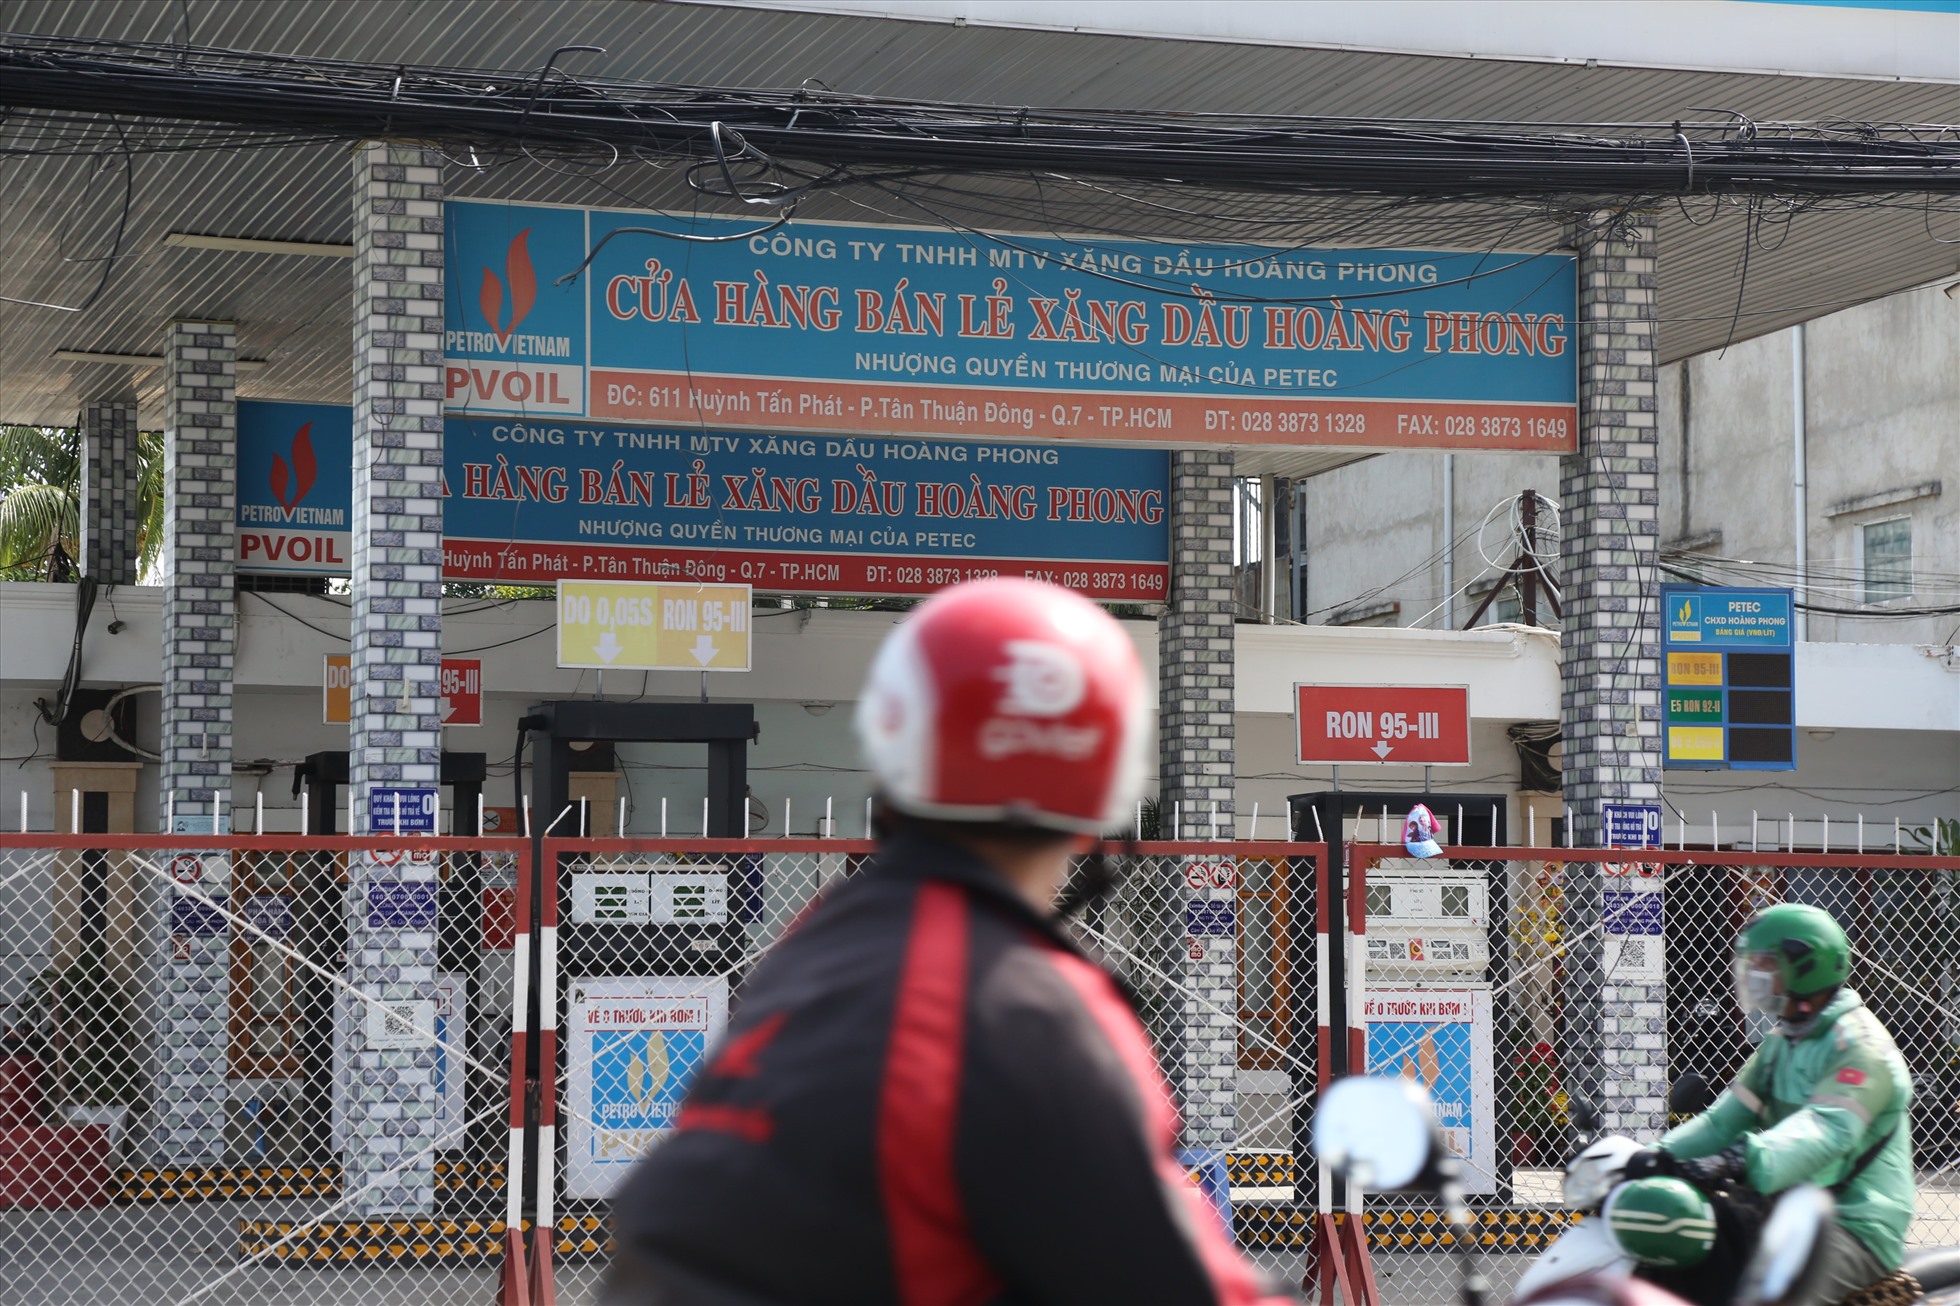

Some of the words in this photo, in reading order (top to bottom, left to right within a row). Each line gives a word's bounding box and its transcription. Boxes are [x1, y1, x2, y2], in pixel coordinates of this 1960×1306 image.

[749, 232, 837, 259] CÔNG
[848, 241, 884, 262] TY
[900, 244, 977, 266] TNHH
[990, 249, 1048, 270] MTV
[1059, 248, 1142, 275] XĂNG
[1153, 250, 1214, 277] DẦU
[1224, 253, 1326, 281] HOÀNG
[1338, 263, 1438, 284] PHONG
[606, 258, 701, 323] CỬA
[714, 270, 842, 332] HÀNG
[855, 277, 945, 336] BÁN
[958, 277, 1015, 340] LẺ
[1028, 289, 1149, 346] XĂNG
[1161, 284, 1250, 349] DẦU
[1264, 295, 1413, 353] HOÀNG
[1424, 309, 1567, 358] PHONG
[445, 330, 570, 357] PETROVIETNAM
[445, 366, 569, 404] PVOIL
[855, 352, 957, 378] NHƯỢNG
[965, 353, 1046, 380] QUYỀN
[1055, 360, 1151, 382] THƯƠNG
[1160, 364, 1202, 389] MẠI
[1208, 360, 1258, 386] CỦA
[1264, 368, 1338, 388] PETEC
[607, 384, 643, 407] ĐC:
[649, 386, 682, 408] 611
[690, 388, 751, 415] Huỳnh
[757, 389, 791, 412] Tấn
[799, 392, 843, 416] Phát
[860, 394, 914, 419] P.Tân
[921, 398, 979, 424] Thuận
[985, 404, 1034, 428] Đông
[1052, 405, 1082, 428] Q.7
[1100, 408, 1172, 429] TP.HCM
[1205, 410, 1236, 433] ĐT:
[1241, 412, 1272, 433] 028
[1277, 413, 1319, 434] 3873
[1324, 413, 1365, 435] 1328
[1397, 414, 1439, 436] FAX:
[1444, 415, 1475, 437] 028
[1481, 416, 1522, 438] 3873
[1527, 417, 1567, 440] 1649
[492, 423, 565, 445] CÔNG
[574, 430, 606, 447] TY
[616, 431, 680, 450] TNHH
[690, 436, 740, 454] MTV
[749, 437, 816, 458] XĂNG
[825, 438, 875, 460] DẦU
[883, 440, 967, 463] HOÀNG
[978, 447, 1059, 465] PHONG
[463, 454, 568, 504] HÀNG
[579, 458, 654, 507] BÁN
[664, 459, 711, 509] LẺ
[722, 468, 820, 514] XĂNG
[831, 463, 906, 516] DẦU
[915, 473, 1037, 521] HOÀNG
[1047, 486, 1164, 525] PHONG
[241, 504, 344, 526] PETROVIETNAM
[240, 534, 343, 564] PVOIL
[578, 519, 662, 540] NHƯỢNG
[670, 519, 737, 541] QUYỀN
[744, 526, 823, 544] THƯƠNG
[830, 528, 863, 549] MẠI
[870, 527, 910, 547] CỦA
[915, 532, 976, 548] PETEC
[498, 551, 528, 571] Tấn
[533, 553, 567, 573] Phát
[583, 555, 627, 576] P.Tân
[634, 557, 681, 580] Thuận
[685, 559, 726, 583] Đông
[740, 563, 766, 582] Q.7
[779, 564, 840, 582] TP.HCM
[867, 566, 893, 583] ĐT:
[897, 567, 922, 585] 028
[926, 568, 960, 585] 3873
[965, 569, 998, 586] 1328
[1025, 570, 1058, 588] FAX:
[1063, 571, 1088, 589] 028
[1092, 572, 1126, 590] 3873
[1130, 573, 1163, 591] 1649
[564, 595, 590, 625] DO
[596, 597, 653, 630] 0,05S
[663, 599, 697, 631] RON
[703, 600, 746, 632] 95-III
[1704, 616, 1726, 625] CHXD
[1728, 615, 1756, 625] HOÀNG
[1758, 617, 1786, 625] PHONG
[1728, 601, 1761, 613] PETEC
[328, 665, 350, 688] DO
[442, 669, 478, 694] 95-III
[1671, 699, 1681, 712] E5
[1684, 699, 1700, 712] RON
[1702, 700, 1720, 713] 92-II
[1326, 711, 1372, 738] RON
[1380, 712, 1439, 739] 95-III
[422, 794, 434, 815] 0
[378, 818, 394, 826] TRƯỚ
[1648, 811, 1658, 830] 0
